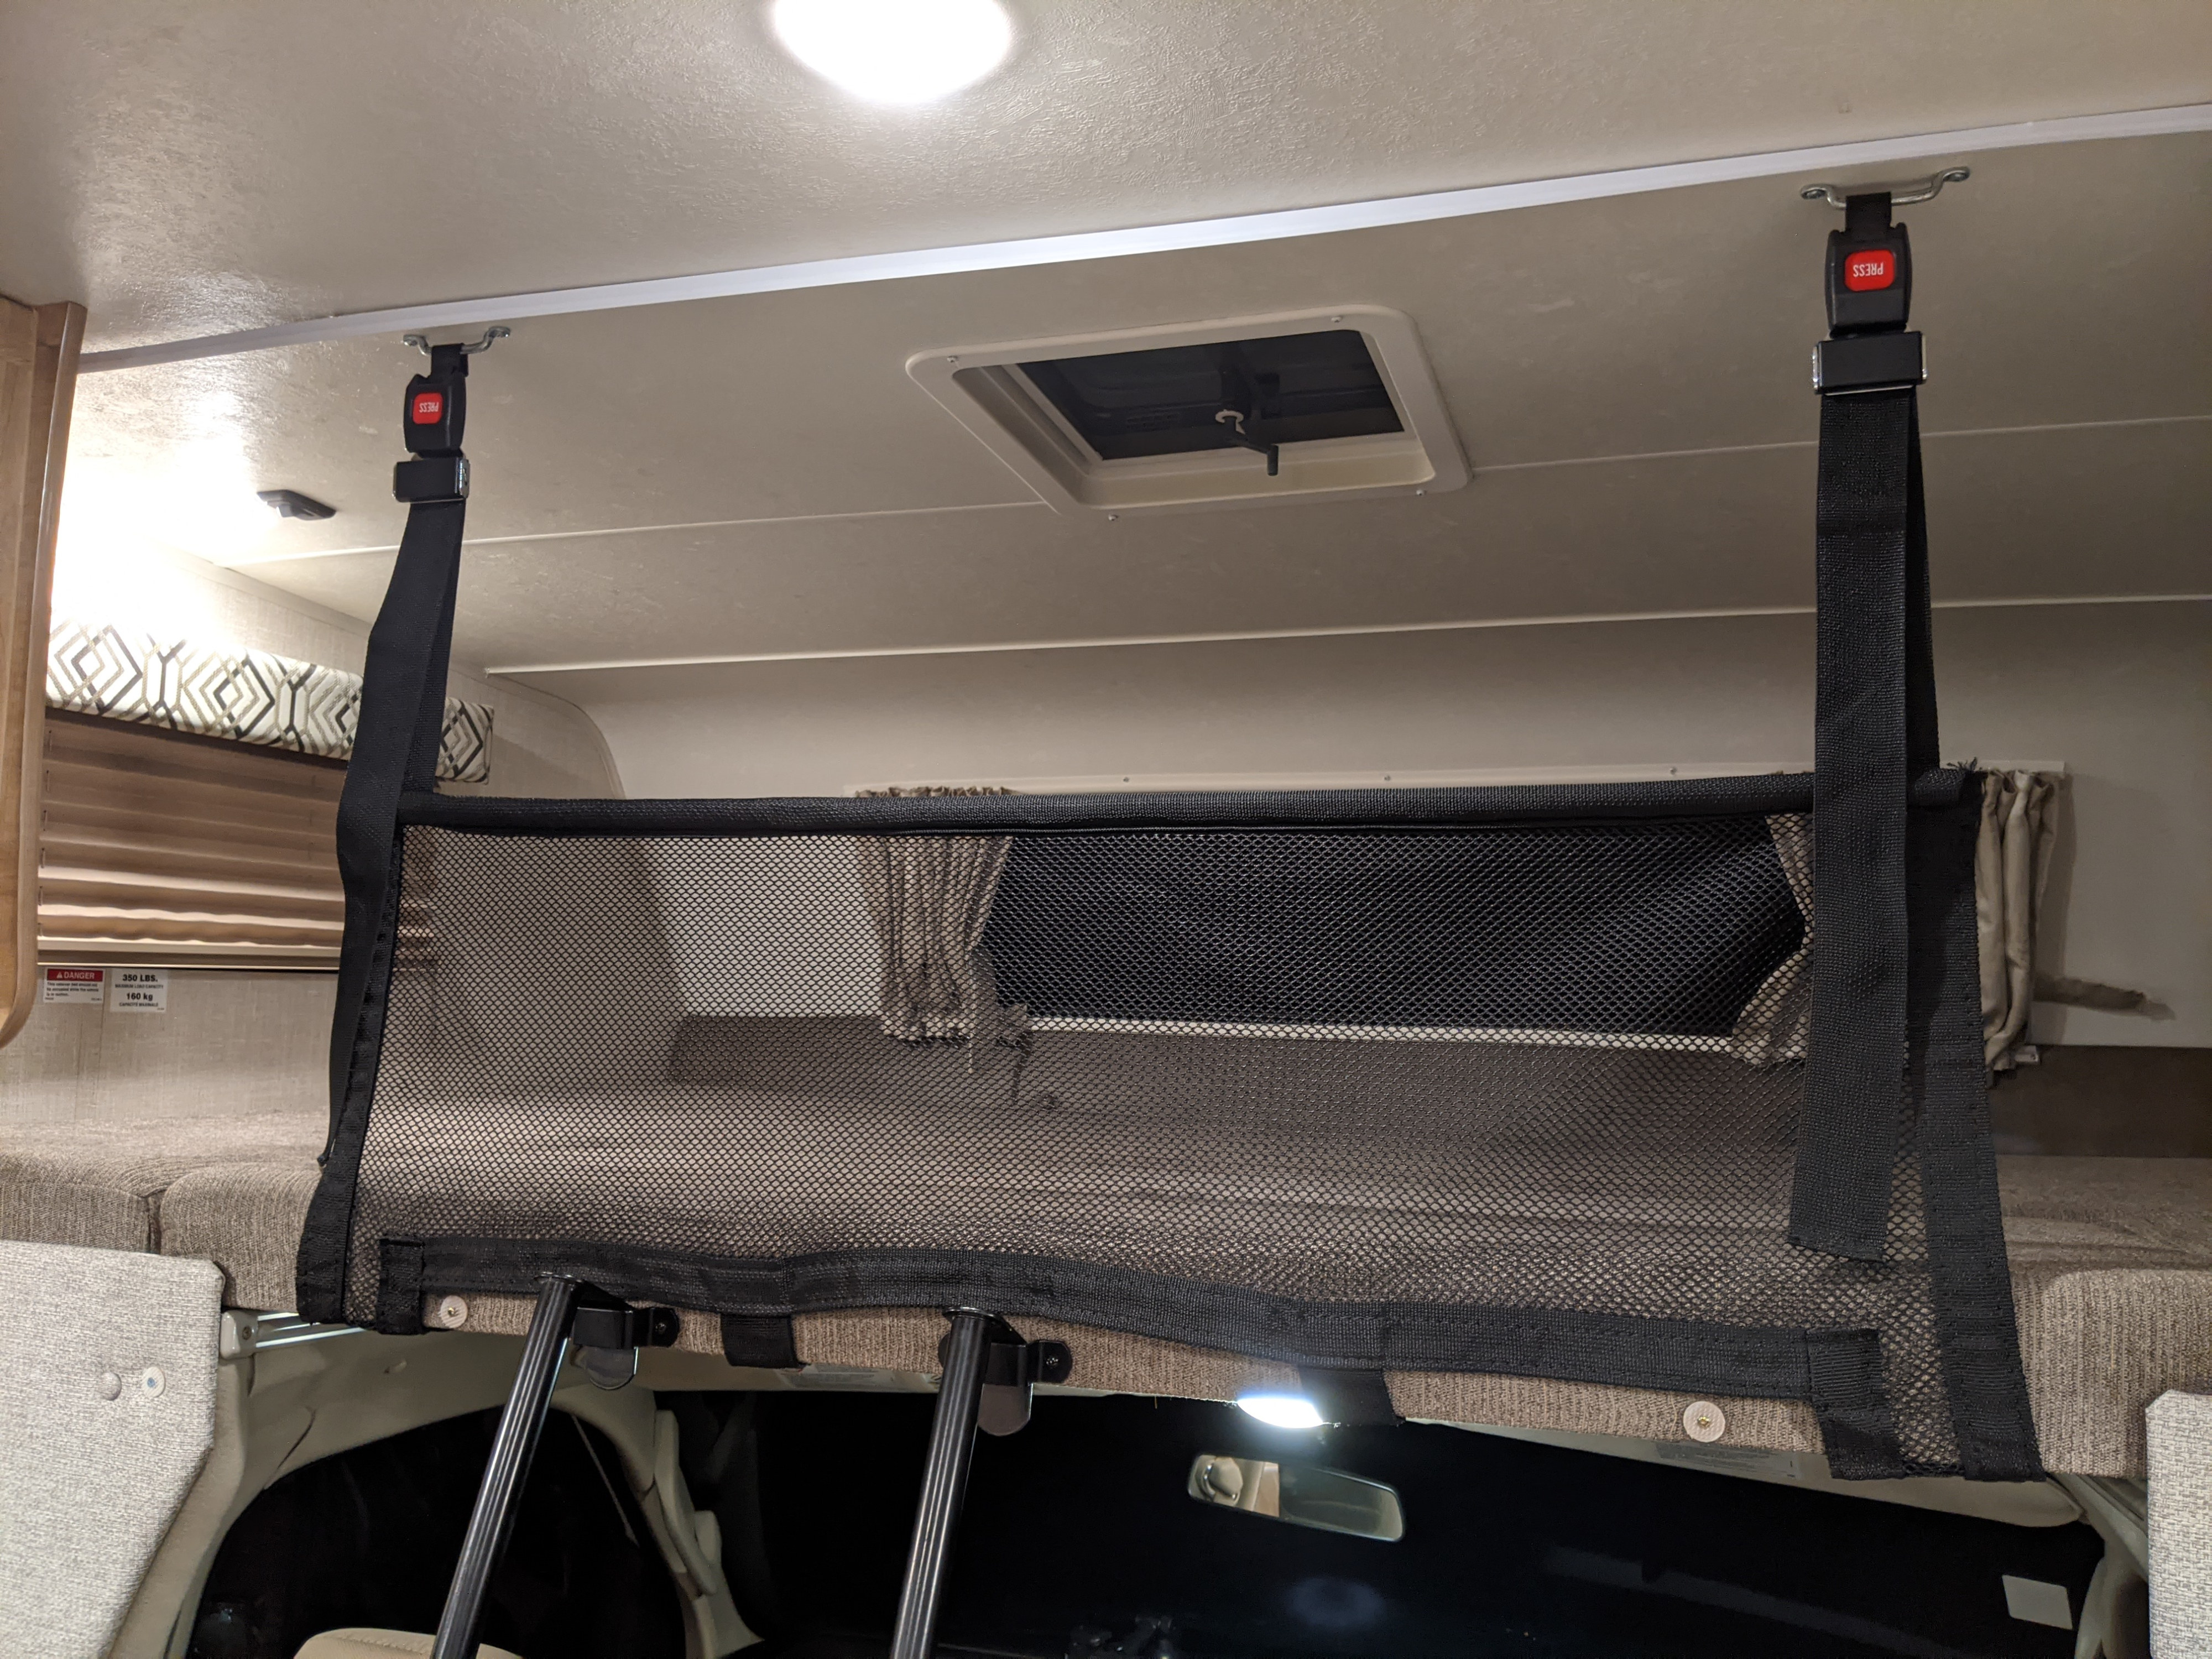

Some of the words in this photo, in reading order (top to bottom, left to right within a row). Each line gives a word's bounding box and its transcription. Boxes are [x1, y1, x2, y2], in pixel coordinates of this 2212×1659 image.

[1853, 262, 1884, 277] PRESS
[419, 401, 439, 413] PRESS
[64, 971, 95, 979] DANGER
[143, 993, 153, 1001] kg
